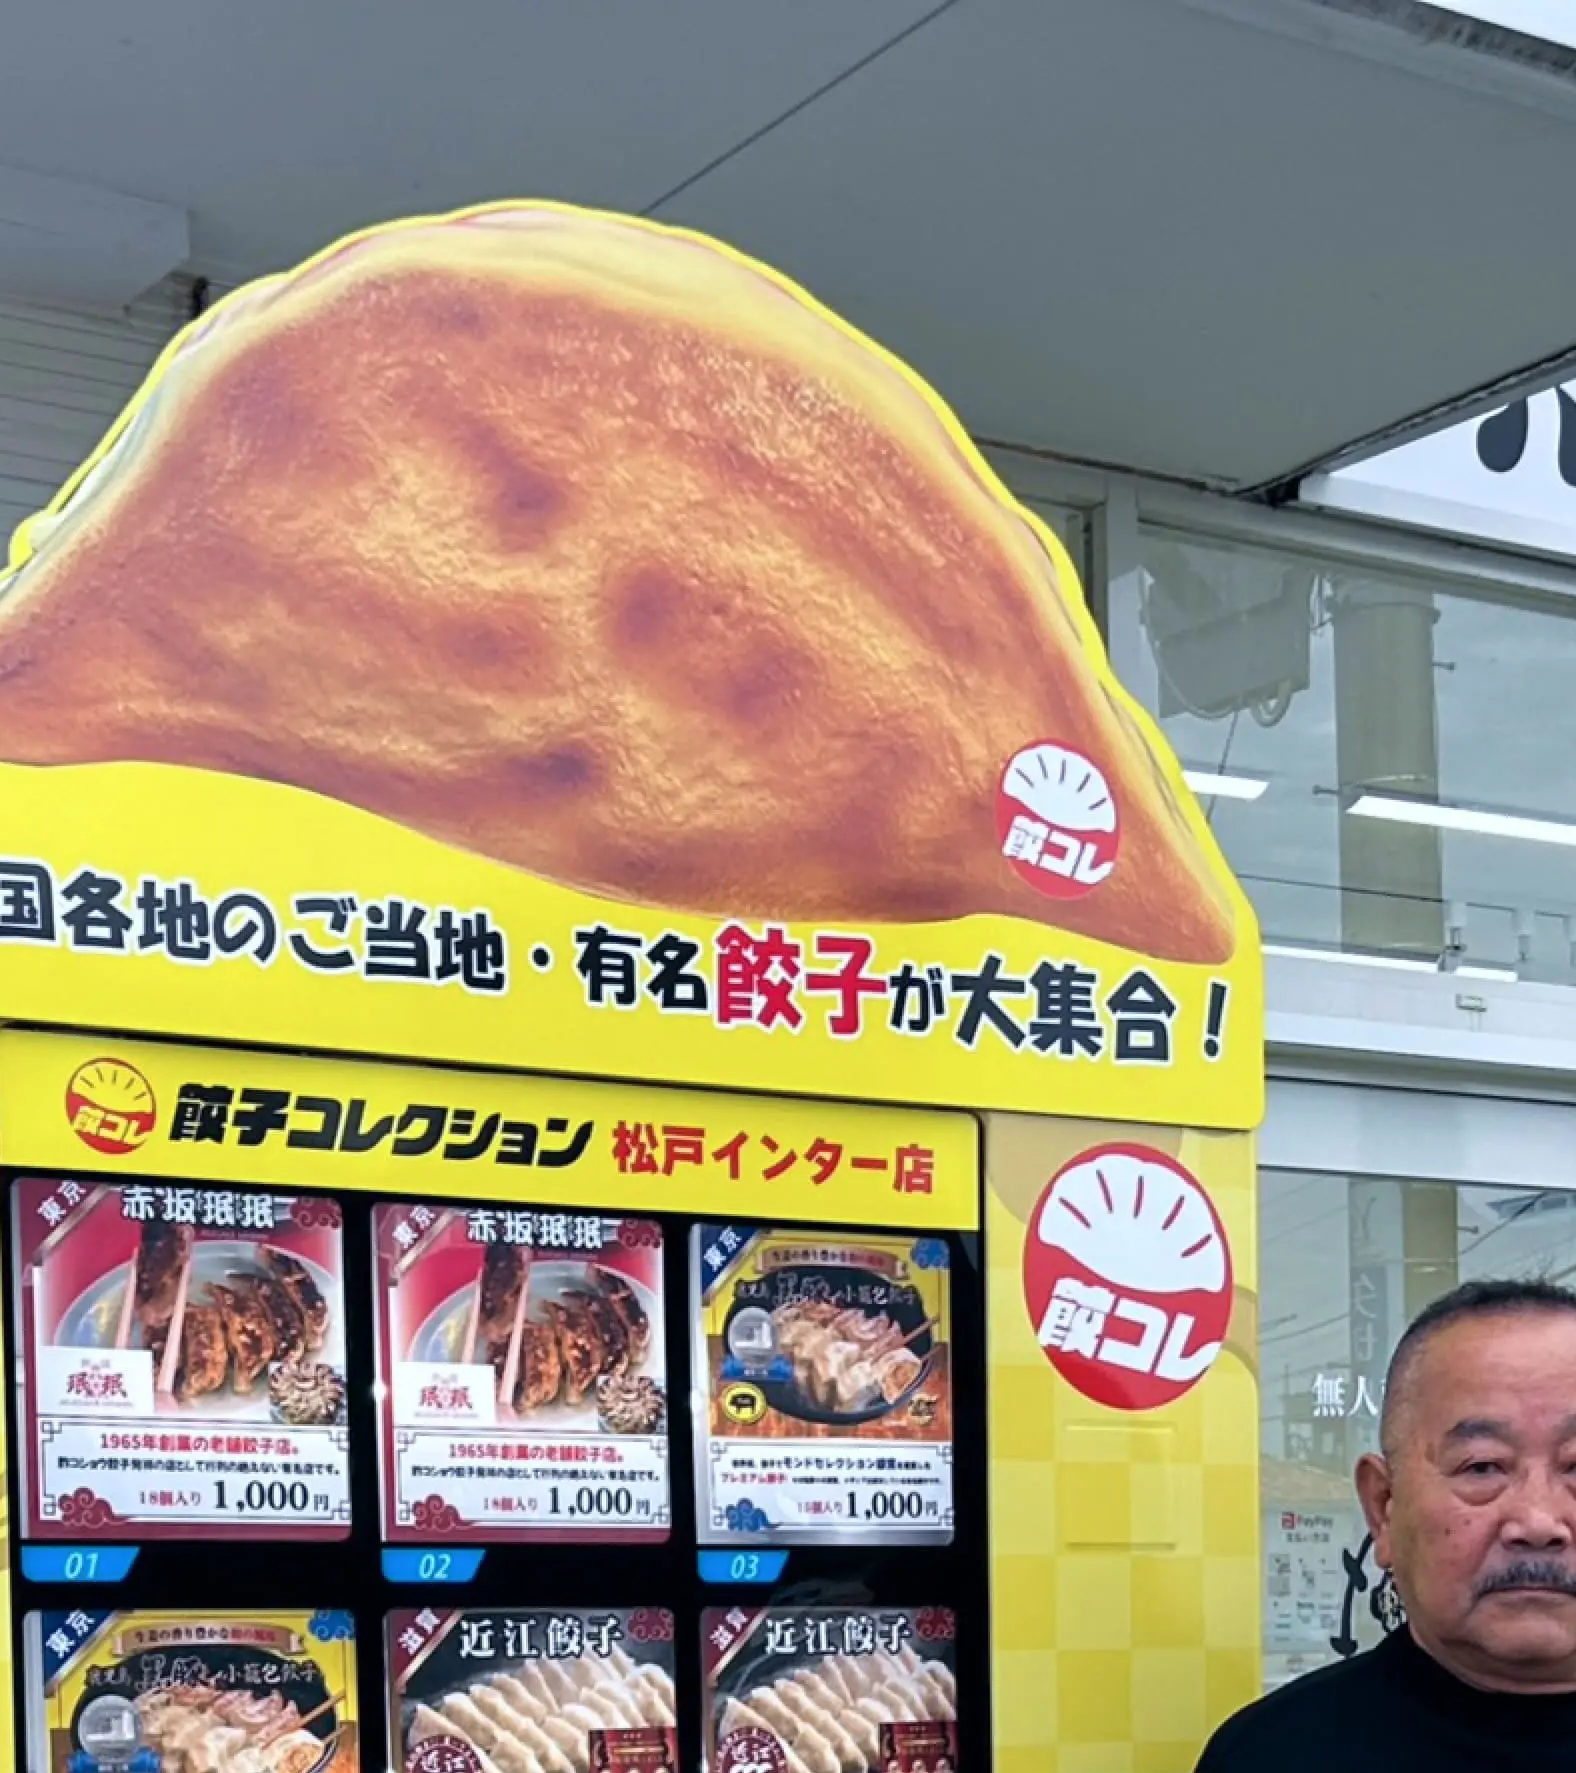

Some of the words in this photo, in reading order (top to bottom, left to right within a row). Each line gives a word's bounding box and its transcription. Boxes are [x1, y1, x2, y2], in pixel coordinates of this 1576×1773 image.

[170, 1083, 593, 1174] 餃子コレクション
[611, 1123, 936, 1196] 松戸インター店
[1041, 1278, 1220, 1380] 餃コレ
[1312, 1373, 1385, 1416] 無人
[212, 1480, 329, 1511] 1,000円
[549, 1487, 650, 1515] 1,000円
[848, 1491, 937, 1519] 1,000円
[64, 1552, 99, 1580] 01
[418, 1553, 452, 1580] 02
[731, 1556, 758, 1579] 03
[458, 1613, 624, 1659] 近江餃子
[765, 1615, 912, 1656] 近江餃子
